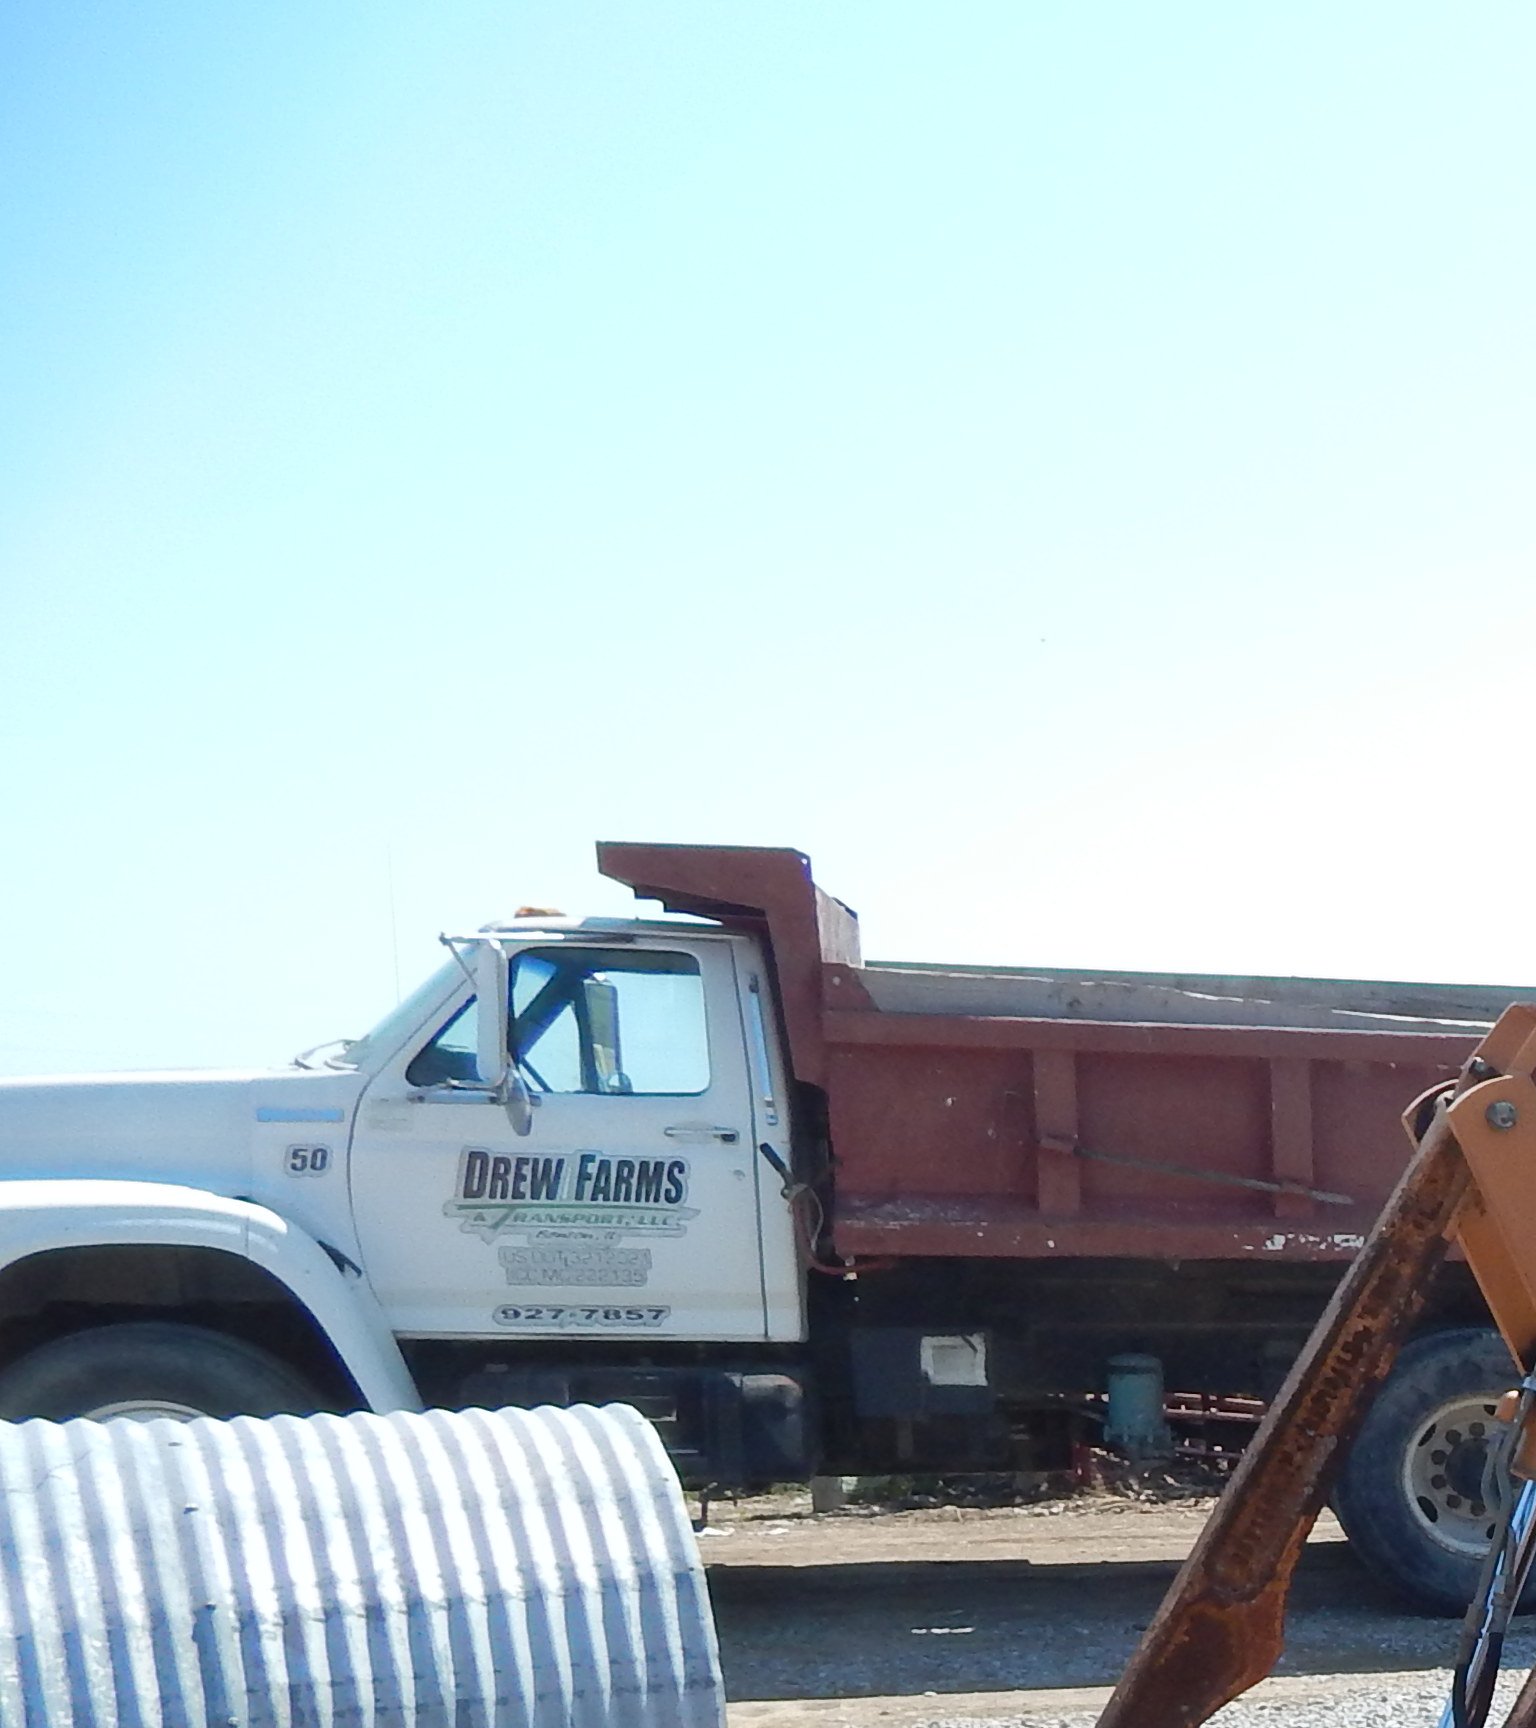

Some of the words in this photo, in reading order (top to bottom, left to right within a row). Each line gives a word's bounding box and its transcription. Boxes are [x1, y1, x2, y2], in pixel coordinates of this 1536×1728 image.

[290, 1147, 328, 1172] 50
[463, 1150, 565, 1201] DREW
[574, 1153, 686, 1204] FARMS
